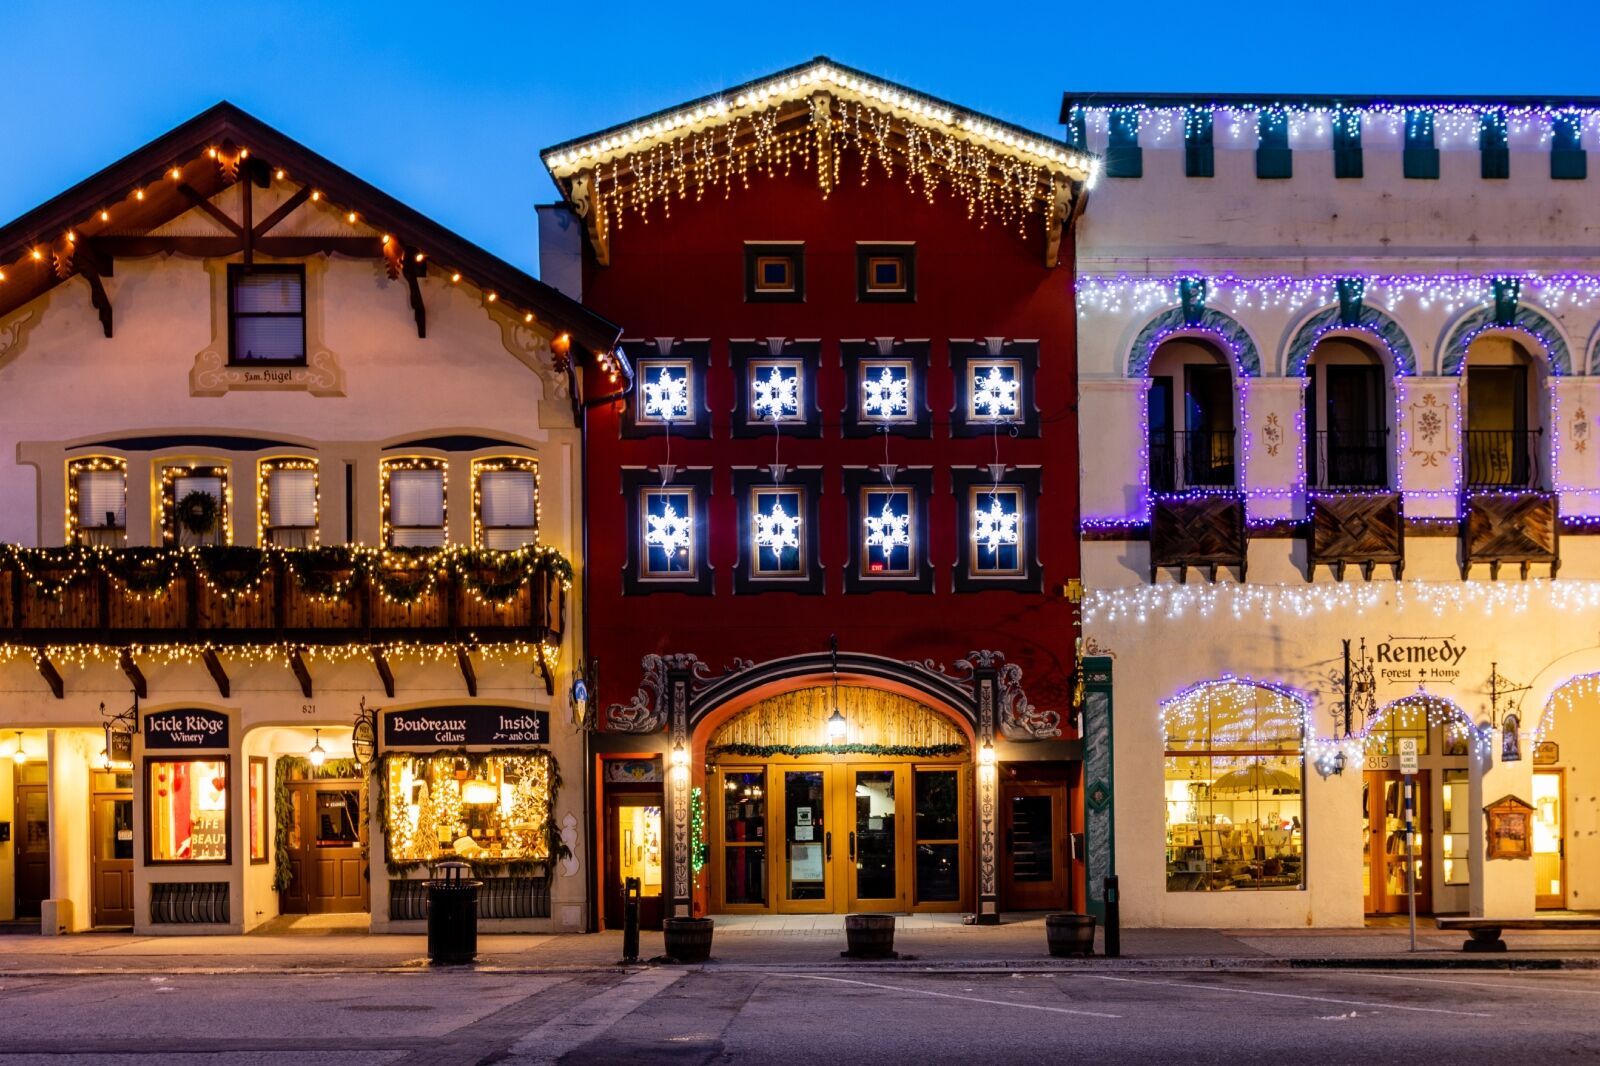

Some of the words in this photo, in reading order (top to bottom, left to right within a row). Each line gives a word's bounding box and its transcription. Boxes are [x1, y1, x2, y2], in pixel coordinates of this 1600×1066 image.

[264, 370, 292, 383] Hügel
[1376, 640, 1467, 666] Remedy
[1381, 668, 1411, 678] Forest
[1431, 668, 1460, 677] Home
[302, 704, 316, 714] 821
[150, 715, 183, 732] Icicle
[185, 715, 224, 735] Ridge
[393, 716, 467, 732] Boudreaux
[499, 715, 540, 730] Inside
[170, 732, 204, 744] Winery
[435, 732, 465, 742] Cellars
[508, 731, 523, 741] and
[524, 732, 540, 741] Out
[1403, 741, 1413, 750] 30
[1368, 756, 1389, 769] 815
